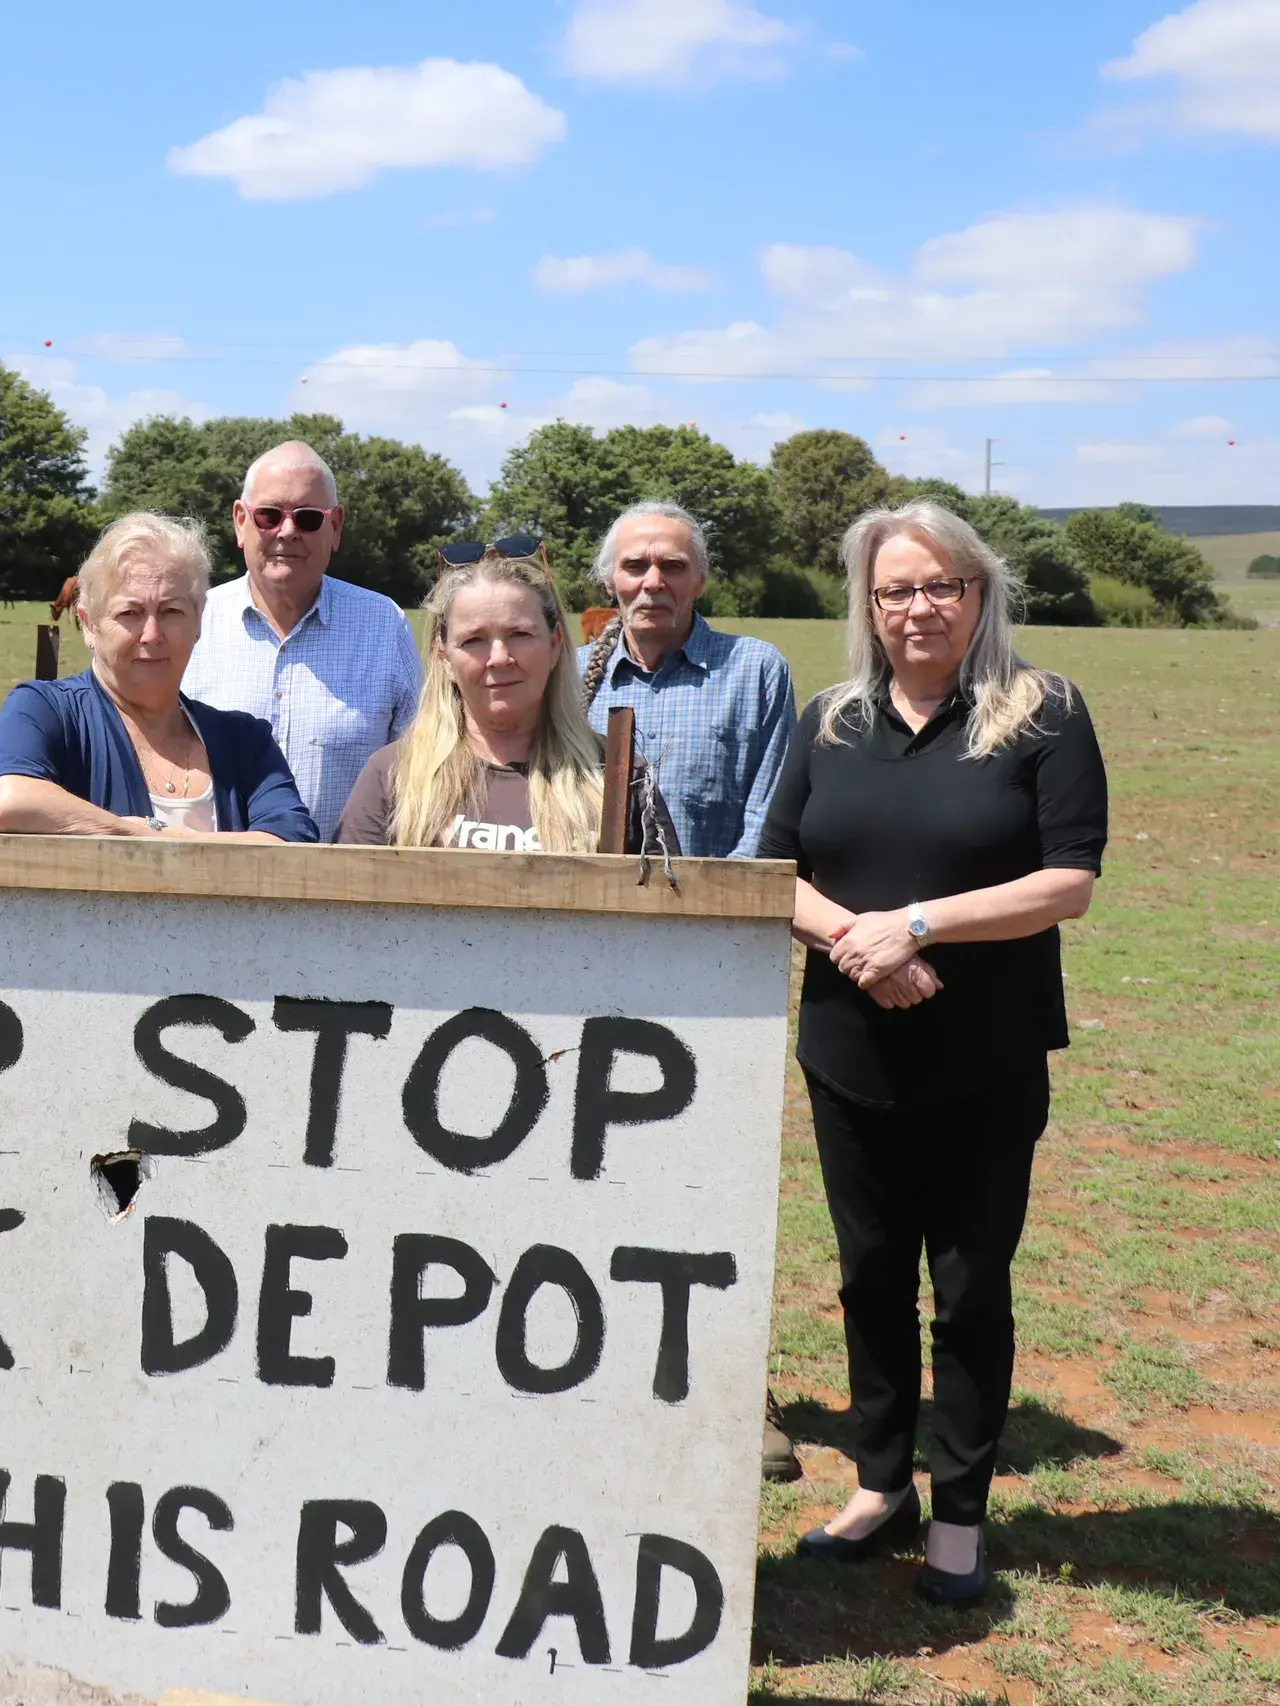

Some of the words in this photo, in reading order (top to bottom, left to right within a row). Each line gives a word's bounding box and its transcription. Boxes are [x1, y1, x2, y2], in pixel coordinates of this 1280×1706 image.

[128, 993, 697, 1181] STOP
[140, 1216, 738, 1403] DEPOT
[294, 1500, 724, 1668] ROAD
